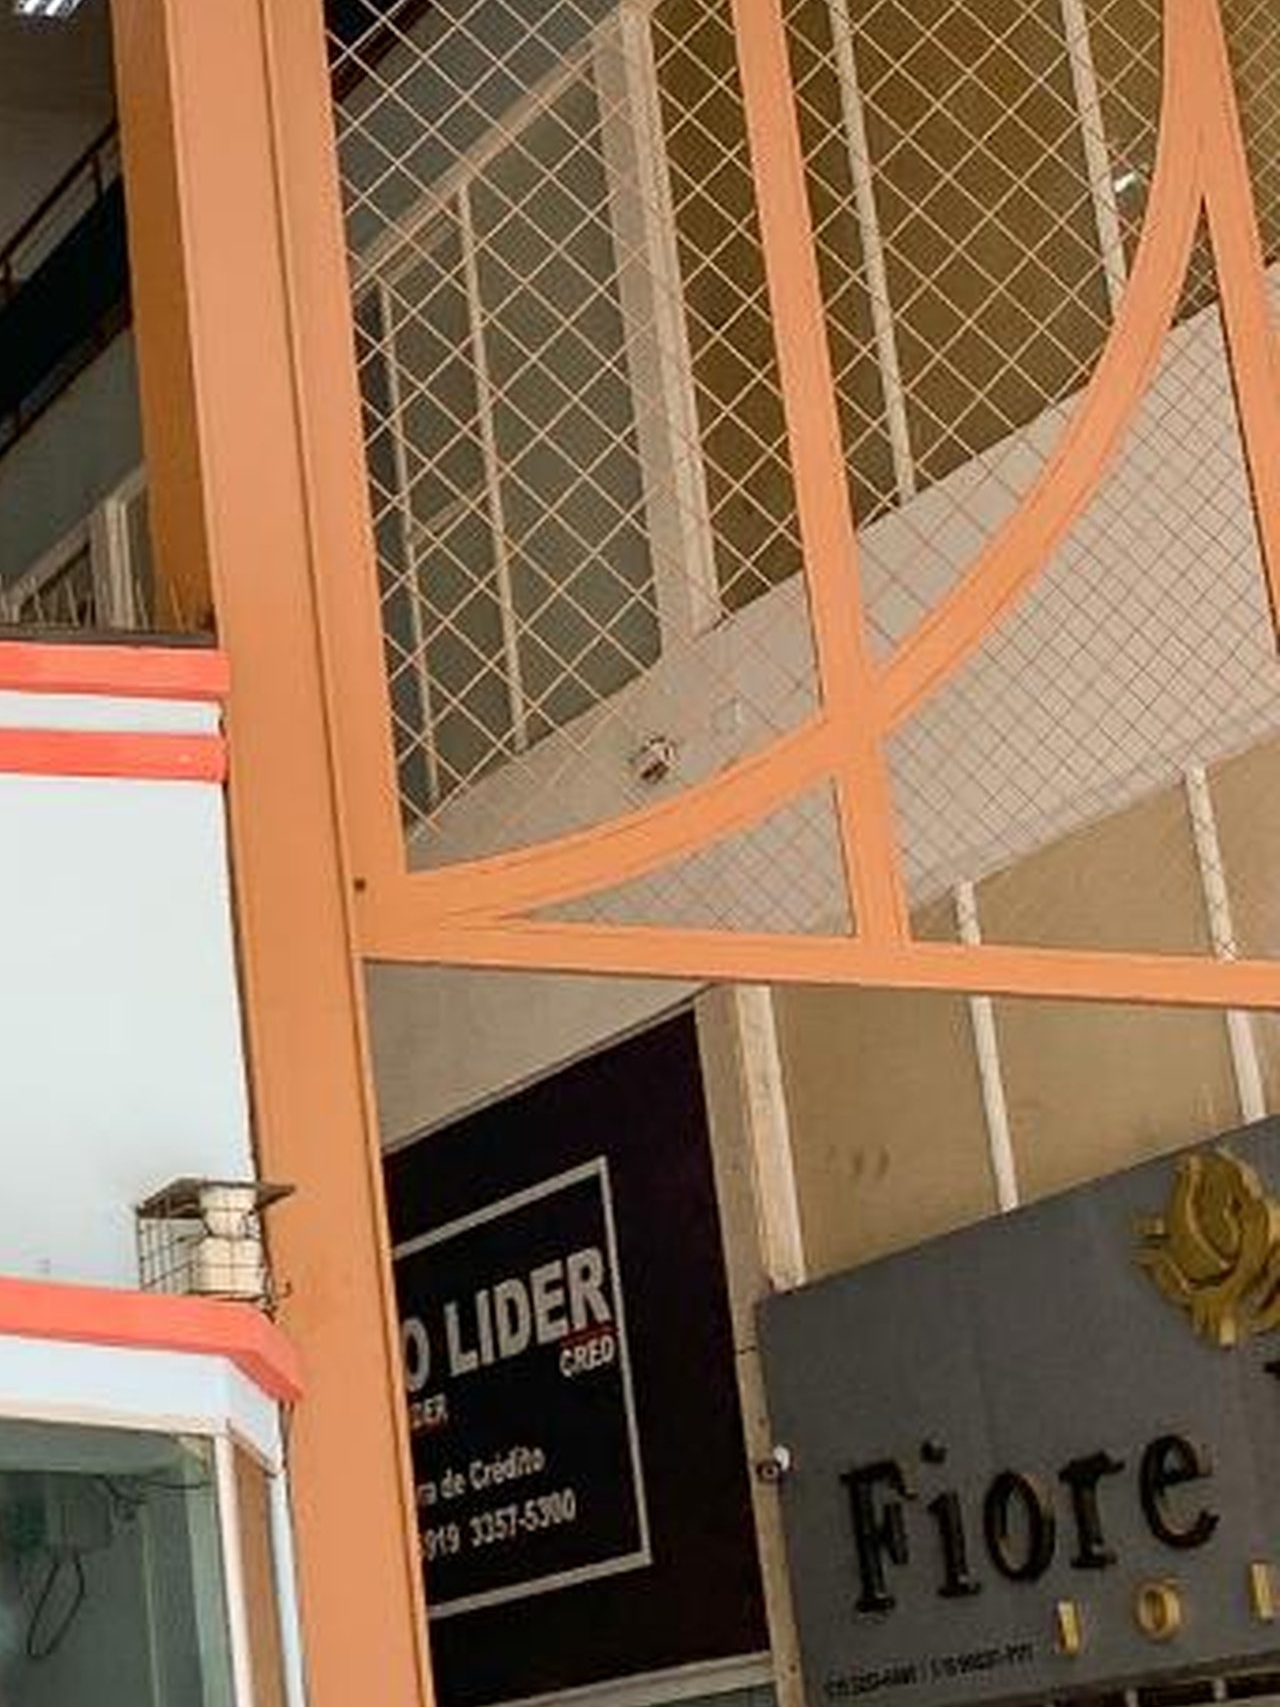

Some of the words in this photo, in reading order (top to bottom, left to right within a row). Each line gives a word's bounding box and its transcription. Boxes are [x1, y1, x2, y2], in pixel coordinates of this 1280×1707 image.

[443, 1248, 612, 1376] LIDER
[559, 1335, 615, 1377] CRED
[441, 1468, 466, 1498] de
[840, 1433, 1220, 1614] Fiore
